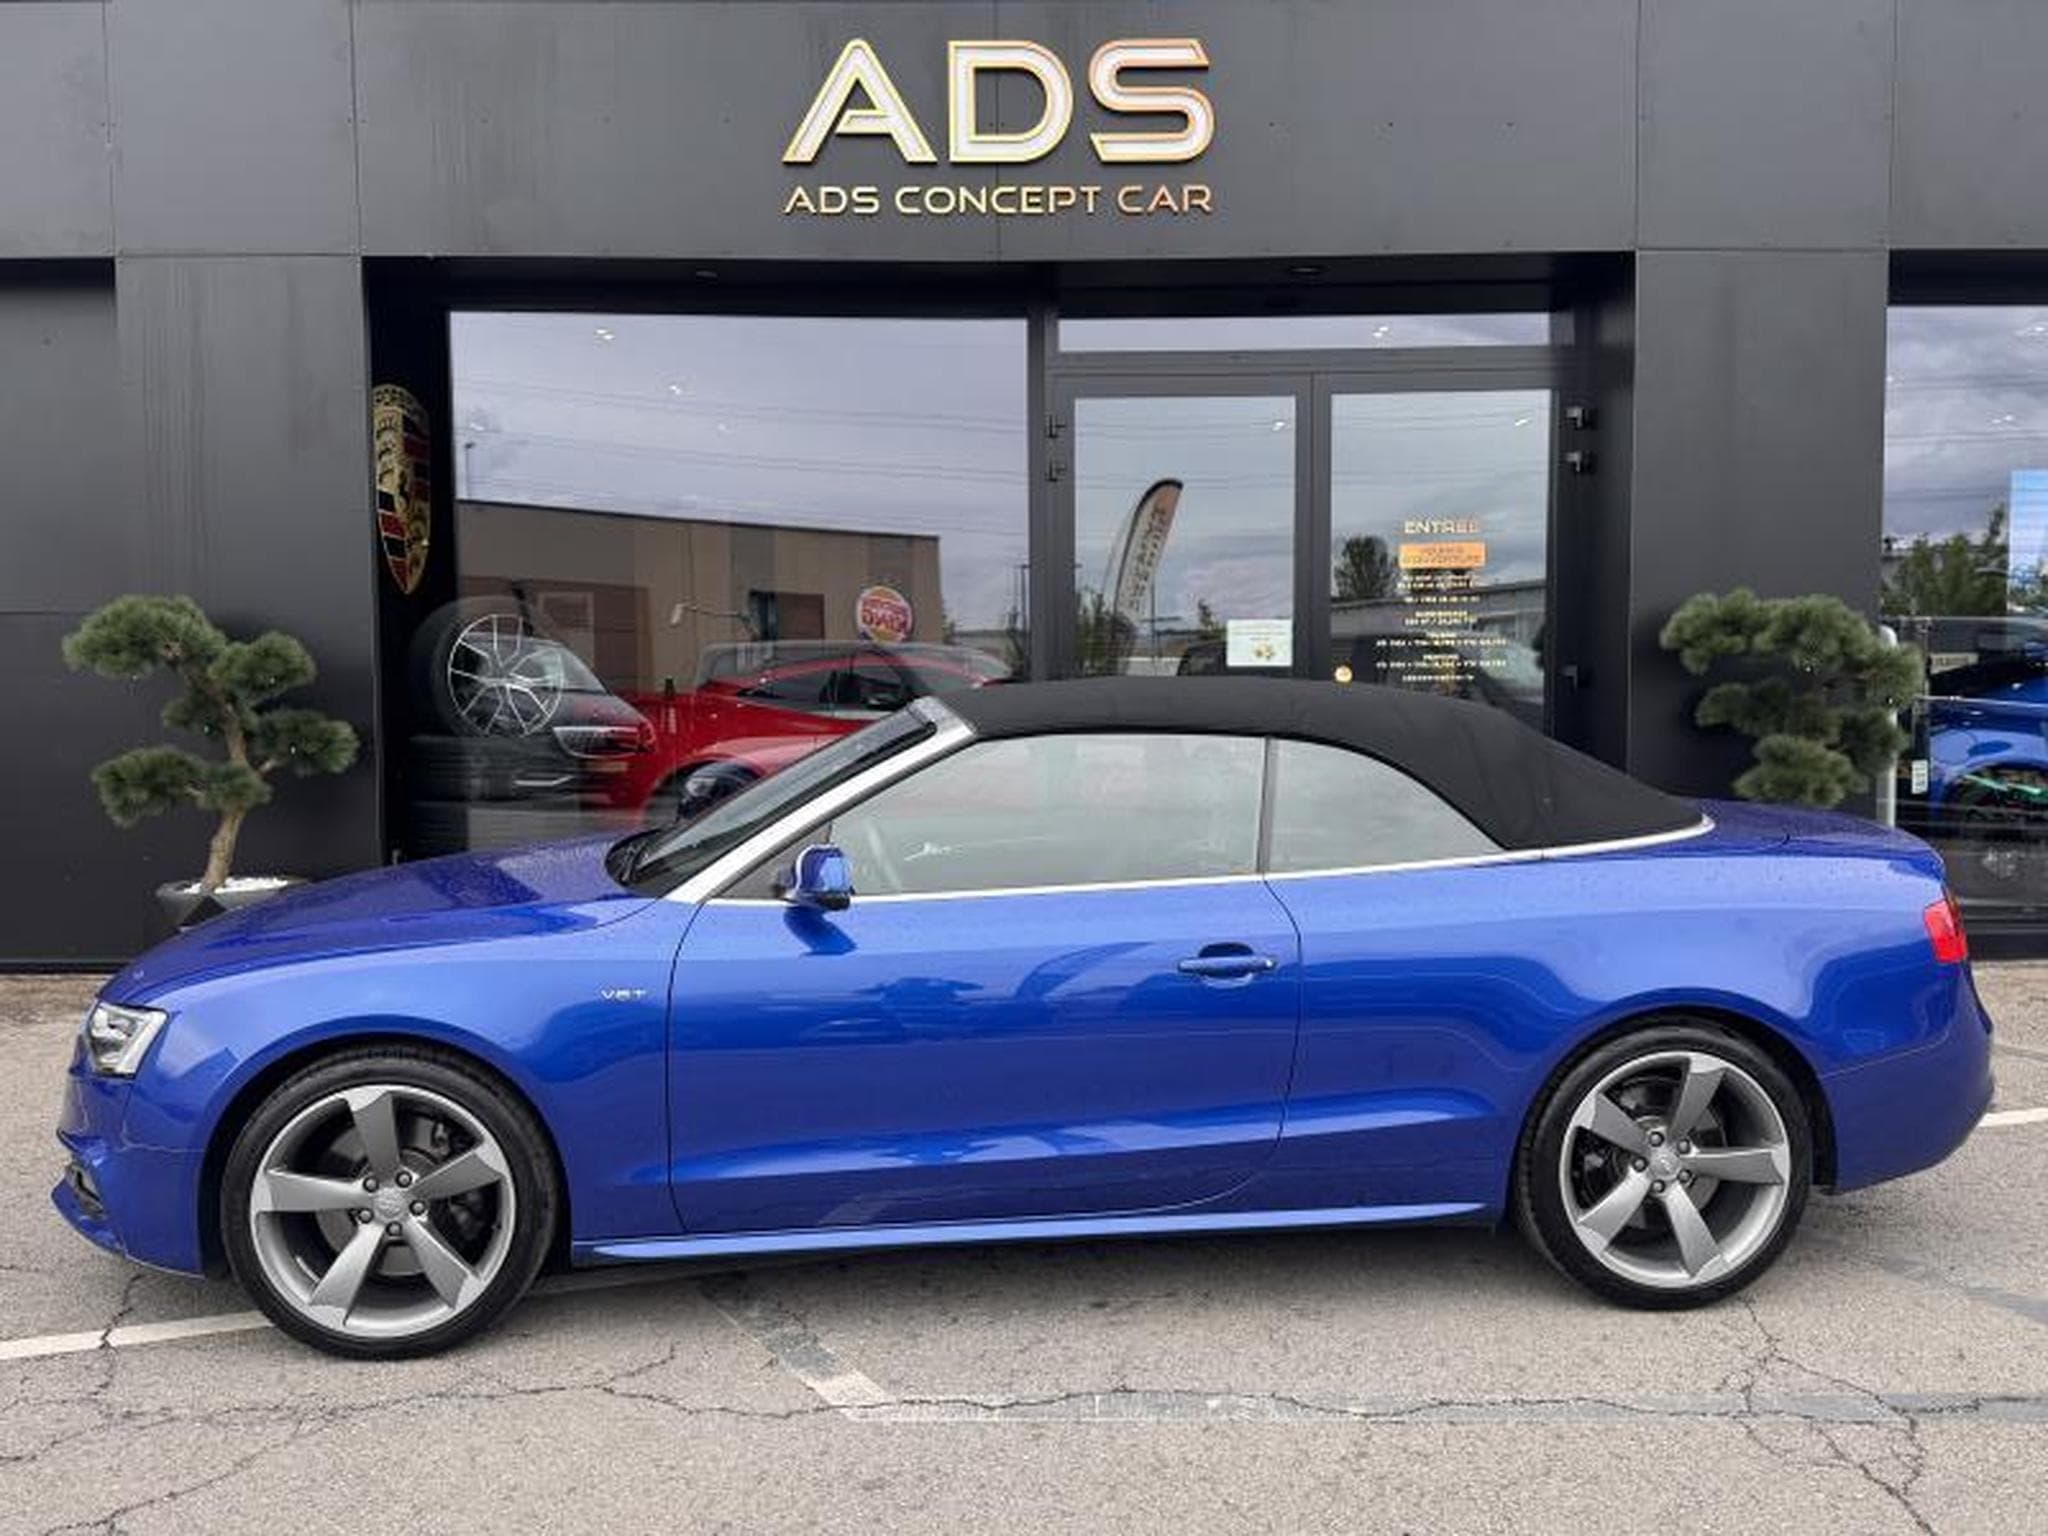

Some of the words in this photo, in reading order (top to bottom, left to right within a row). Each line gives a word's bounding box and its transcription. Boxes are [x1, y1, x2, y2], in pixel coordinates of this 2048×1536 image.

[782, 38, 1216, 163] ADS
[784, 186, 879, 213] ADS
[895, 186, 1100, 214] CONCEPT
[1117, 185, 1213, 213] CAR
